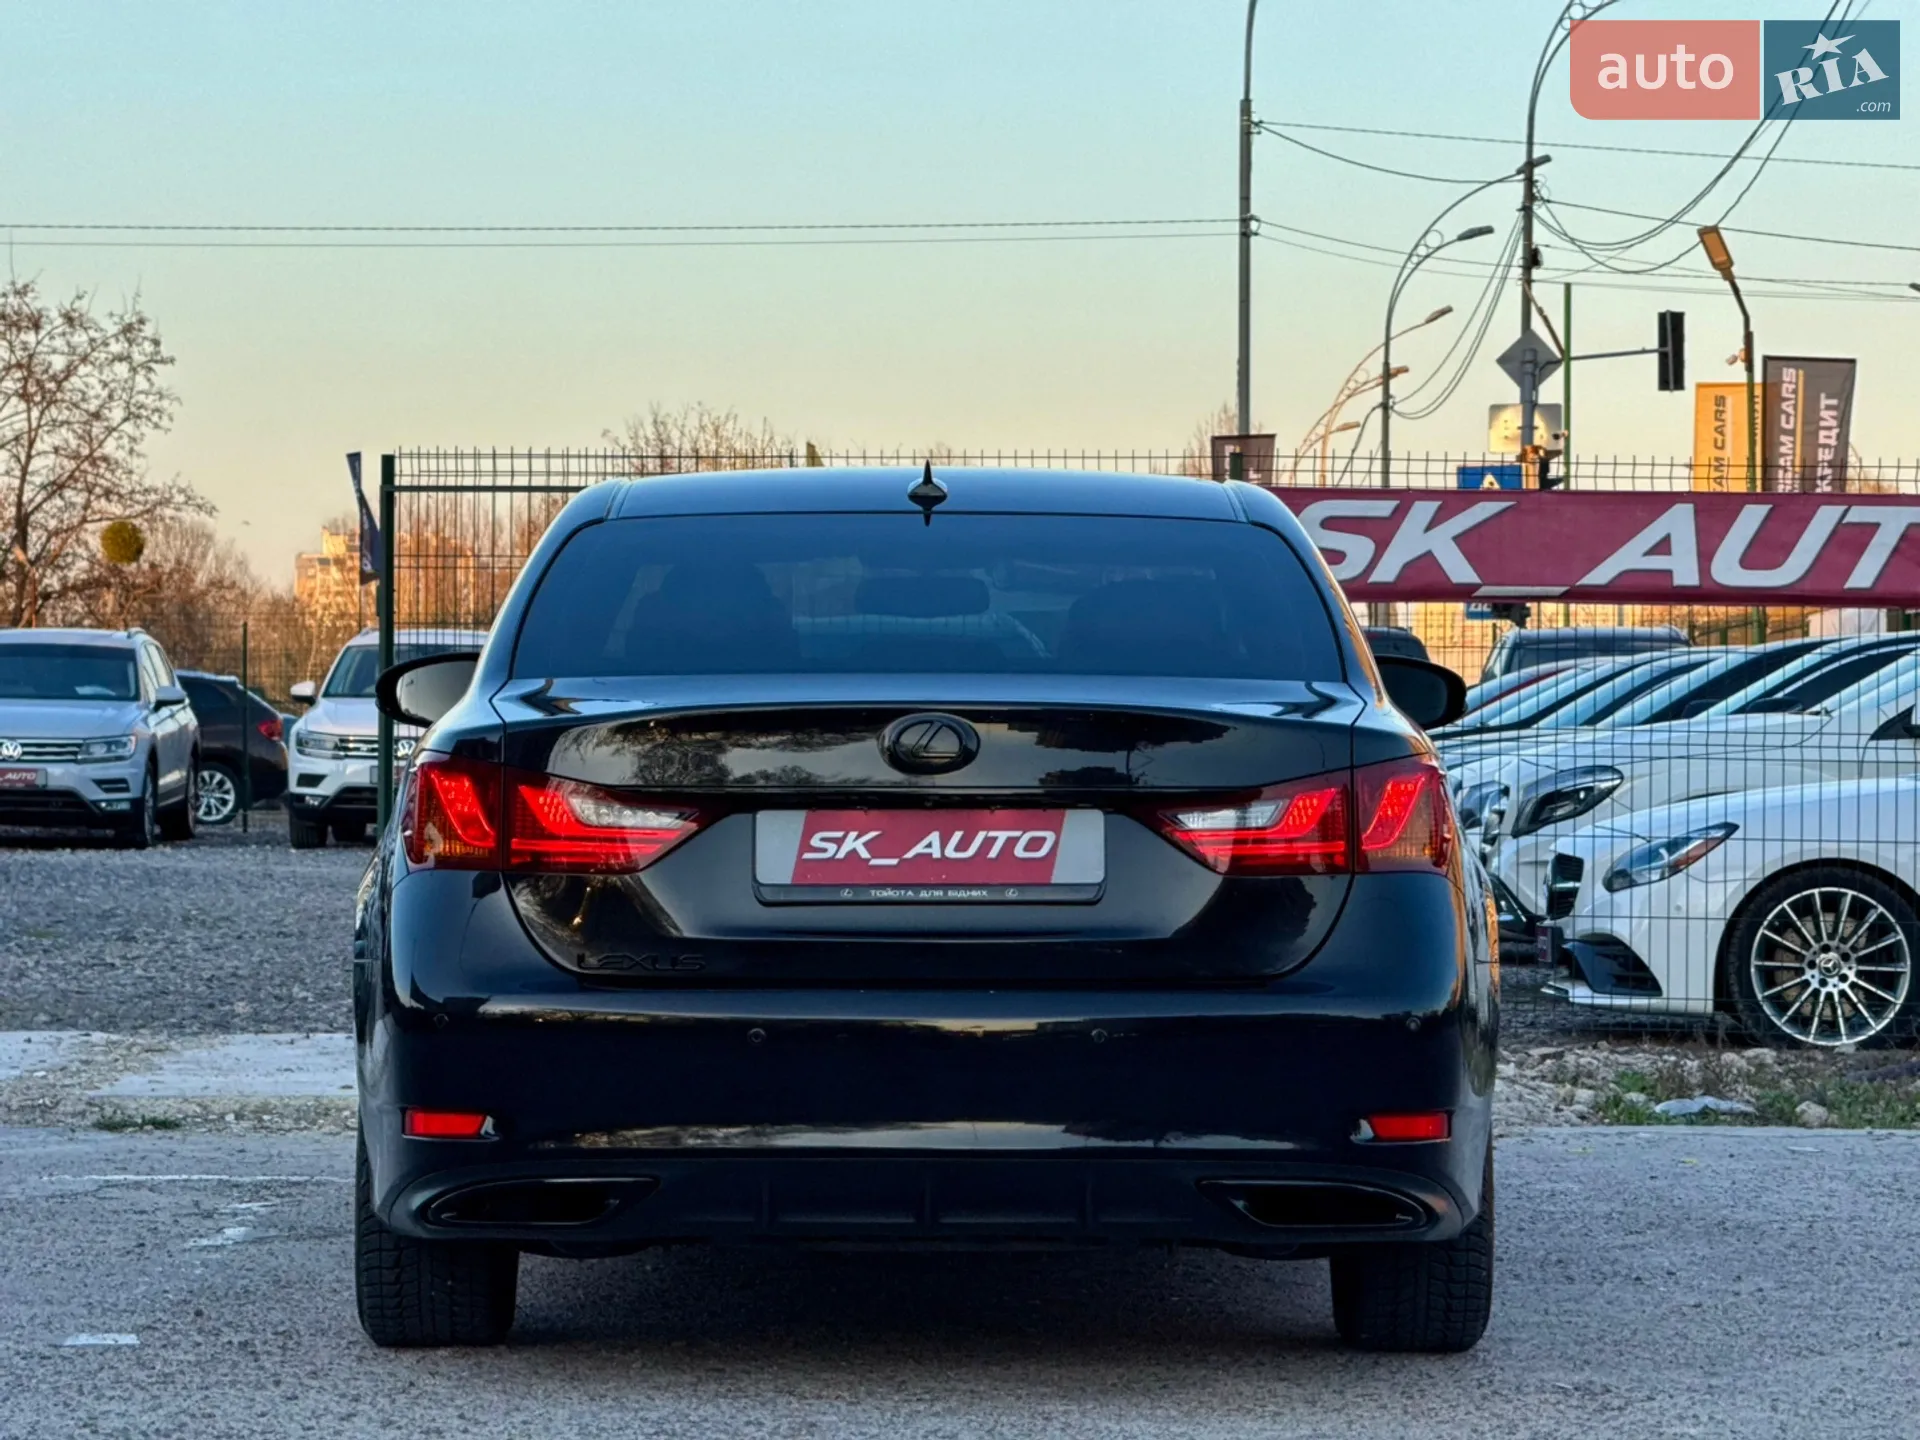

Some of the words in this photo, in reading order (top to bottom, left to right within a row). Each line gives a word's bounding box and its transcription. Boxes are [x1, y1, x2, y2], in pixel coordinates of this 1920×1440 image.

[1781, 367, 1797, 430] CARS
[1713, 394, 1726, 450] CARS
[801, 830, 1056, 865] SK_AUTO
[869, 888, 914, 898] ТОЙОТА
[919, 889, 944, 898] ДЛЯ
[577, 953, 707, 972] LEXUS
